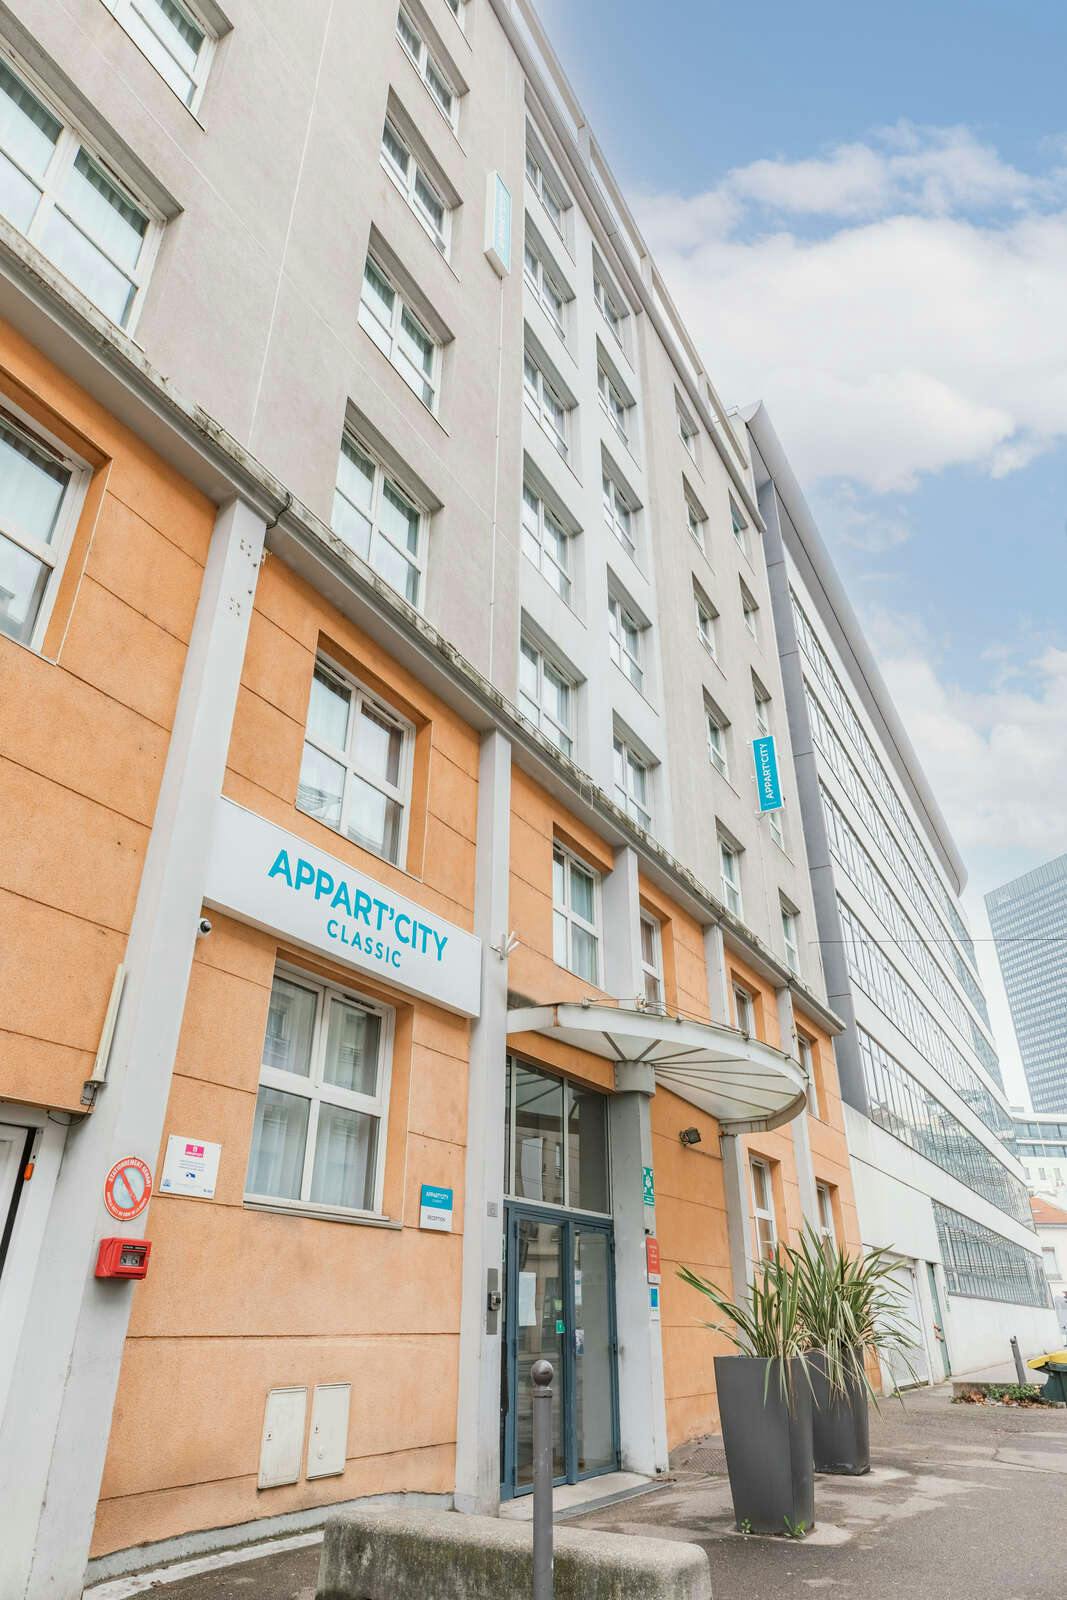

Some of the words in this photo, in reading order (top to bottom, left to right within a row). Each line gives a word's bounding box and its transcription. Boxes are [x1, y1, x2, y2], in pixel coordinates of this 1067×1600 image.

[760, 743, 774, 799] APPART'CITY
[268, 849, 448, 961] APPART'CITY
[326, 920, 401, 968] CLASSIC
